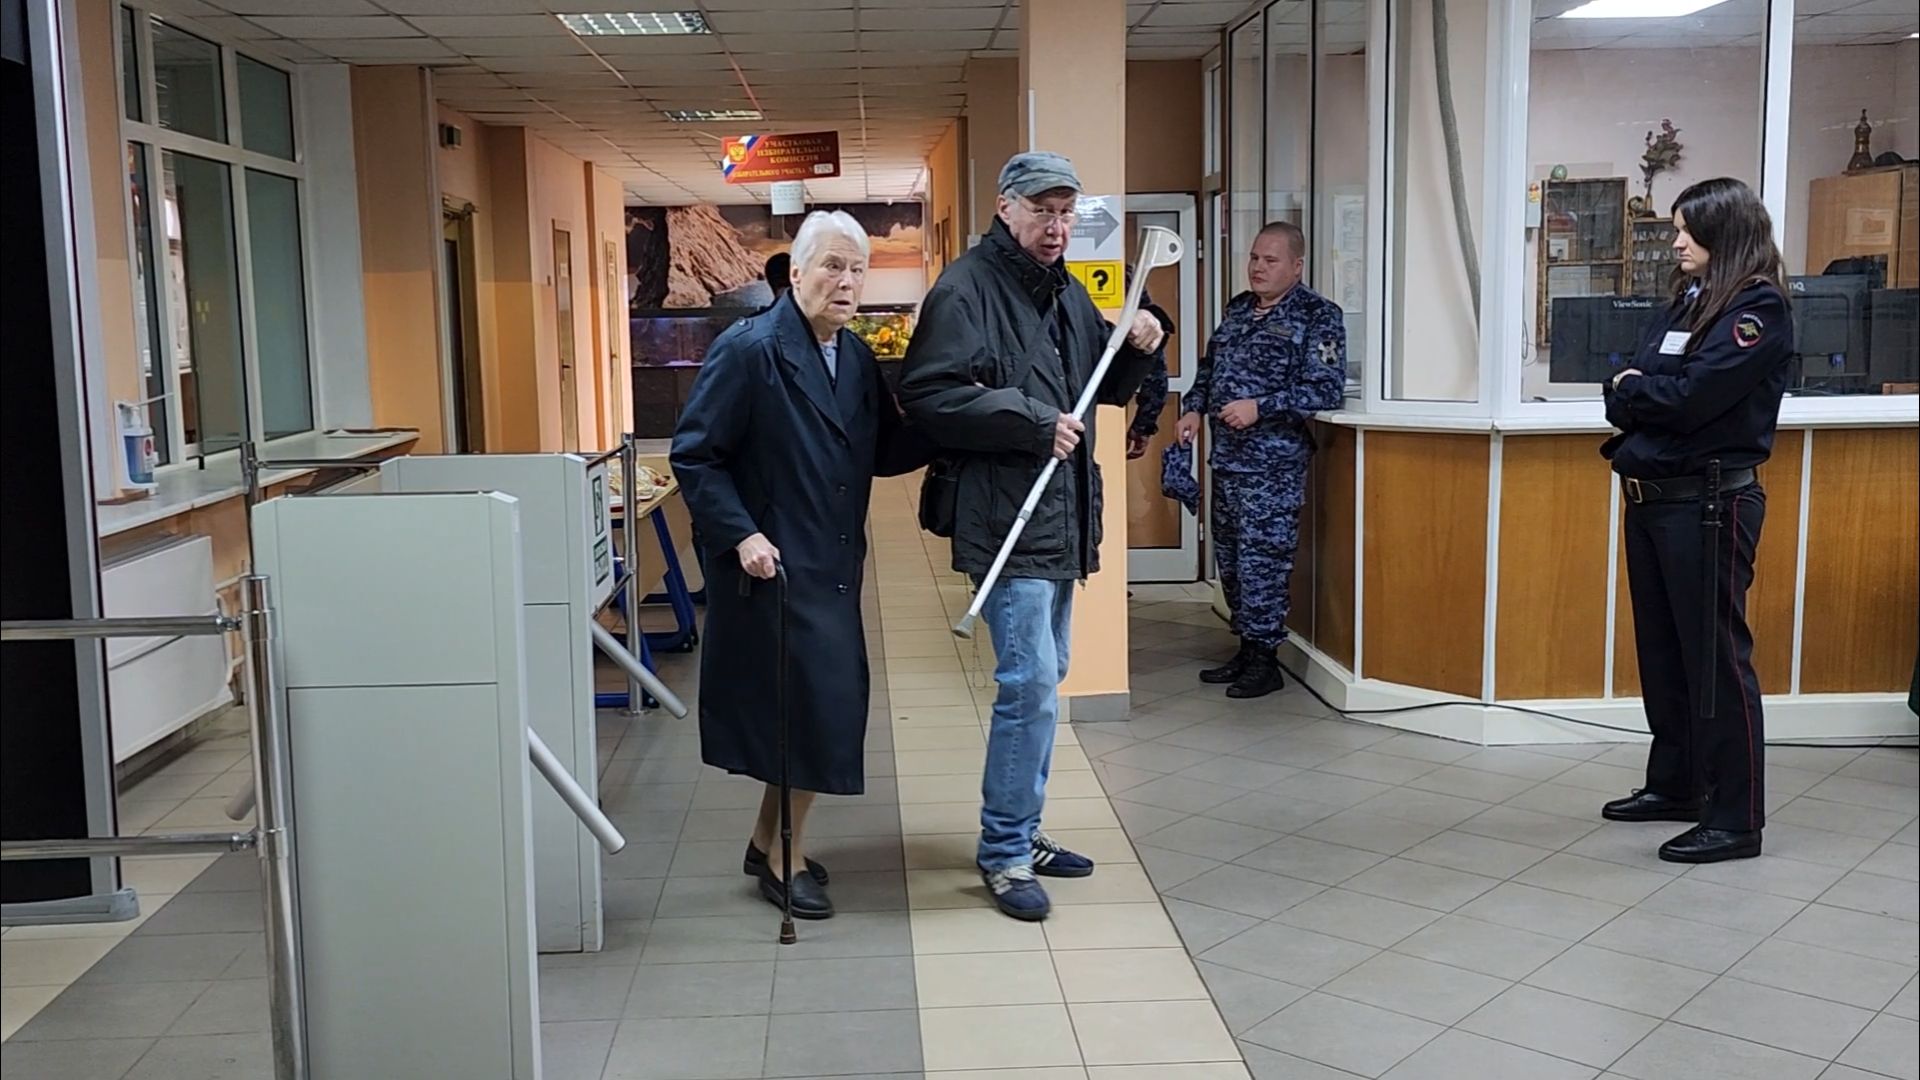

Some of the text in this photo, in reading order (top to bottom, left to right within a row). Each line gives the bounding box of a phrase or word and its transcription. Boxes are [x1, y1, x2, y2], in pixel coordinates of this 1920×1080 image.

[764, 138, 822, 148] УЧАСТКОВАЯ
[756, 146, 831, 157] ИЗБИРАТЕЛЬНАЯ
[769, 154, 820, 164] КОМИССИЯ
[1612, 299, 1653, 308] ViewSonic
